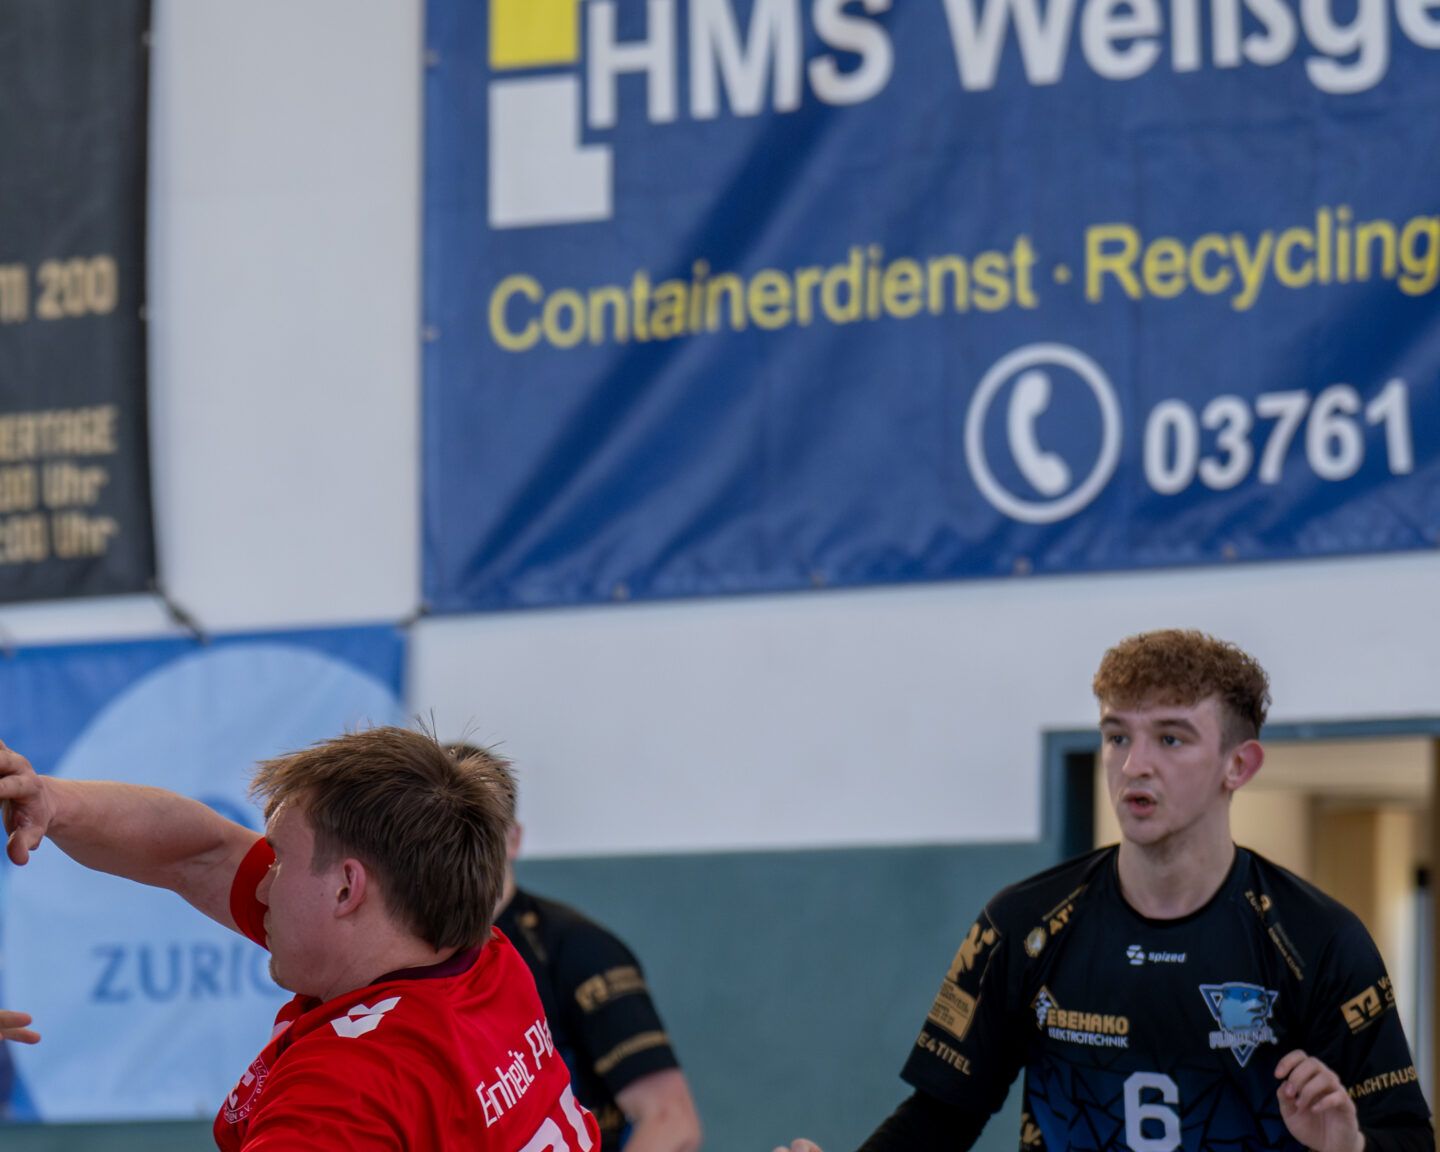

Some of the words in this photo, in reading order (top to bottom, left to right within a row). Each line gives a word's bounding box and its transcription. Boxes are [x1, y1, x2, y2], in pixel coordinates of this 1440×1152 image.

[585, 0, 894, 129] HMS
[946, 0, 1440, 95] Weißg
[36, 254, 118, 320] 200
[488, 234, 1036, 352] Containerdienst
[1084, 205, 1440, 311] Recycling
[1143, 377, 1415, 495] 03761
[1047, 1009, 1130, 1035] EBEHAKO
